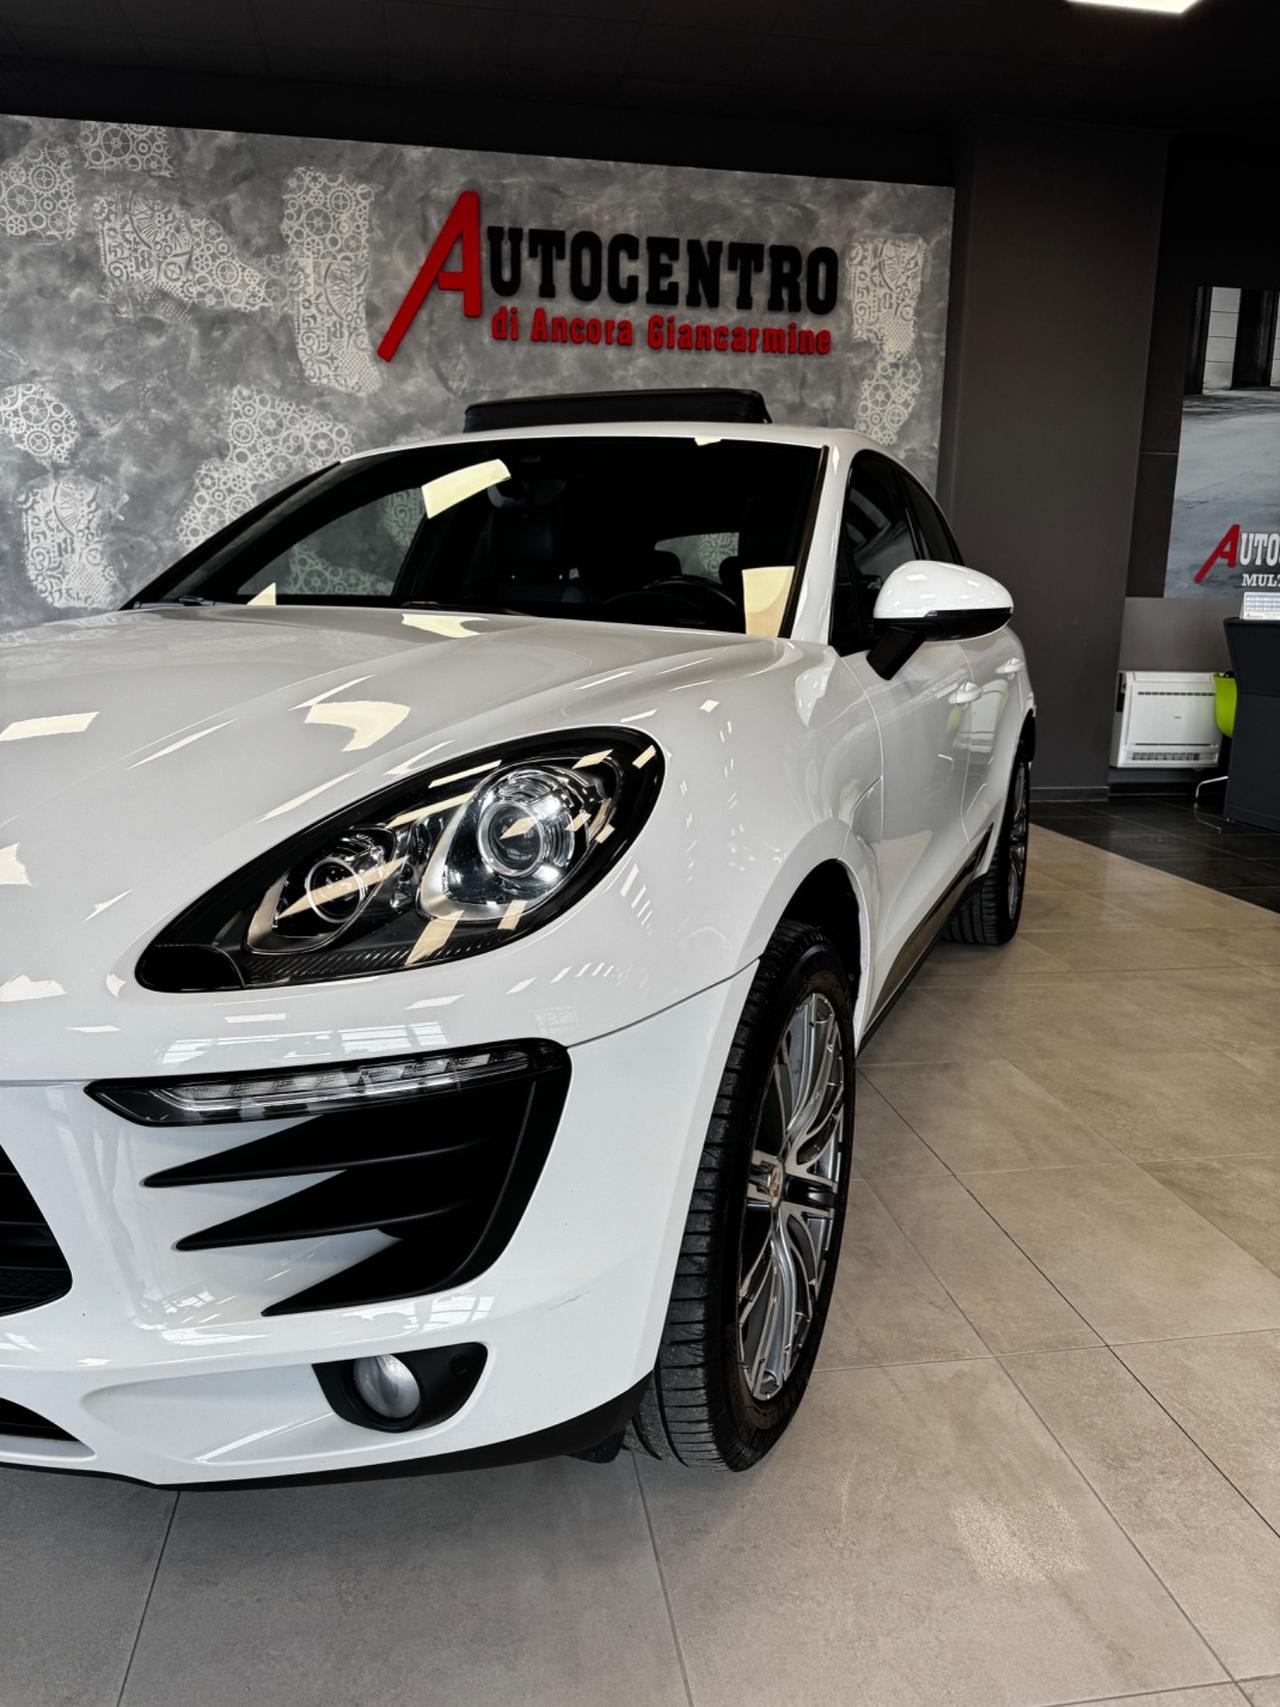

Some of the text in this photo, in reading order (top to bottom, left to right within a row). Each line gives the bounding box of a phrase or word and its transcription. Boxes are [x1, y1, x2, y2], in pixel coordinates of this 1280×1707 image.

[377, 191, 839, 362] AUTOCENTRO
[491, 307, 832, 355] di Ancora Giancarmine
[1194, 523, 1280, 583] AUTO
